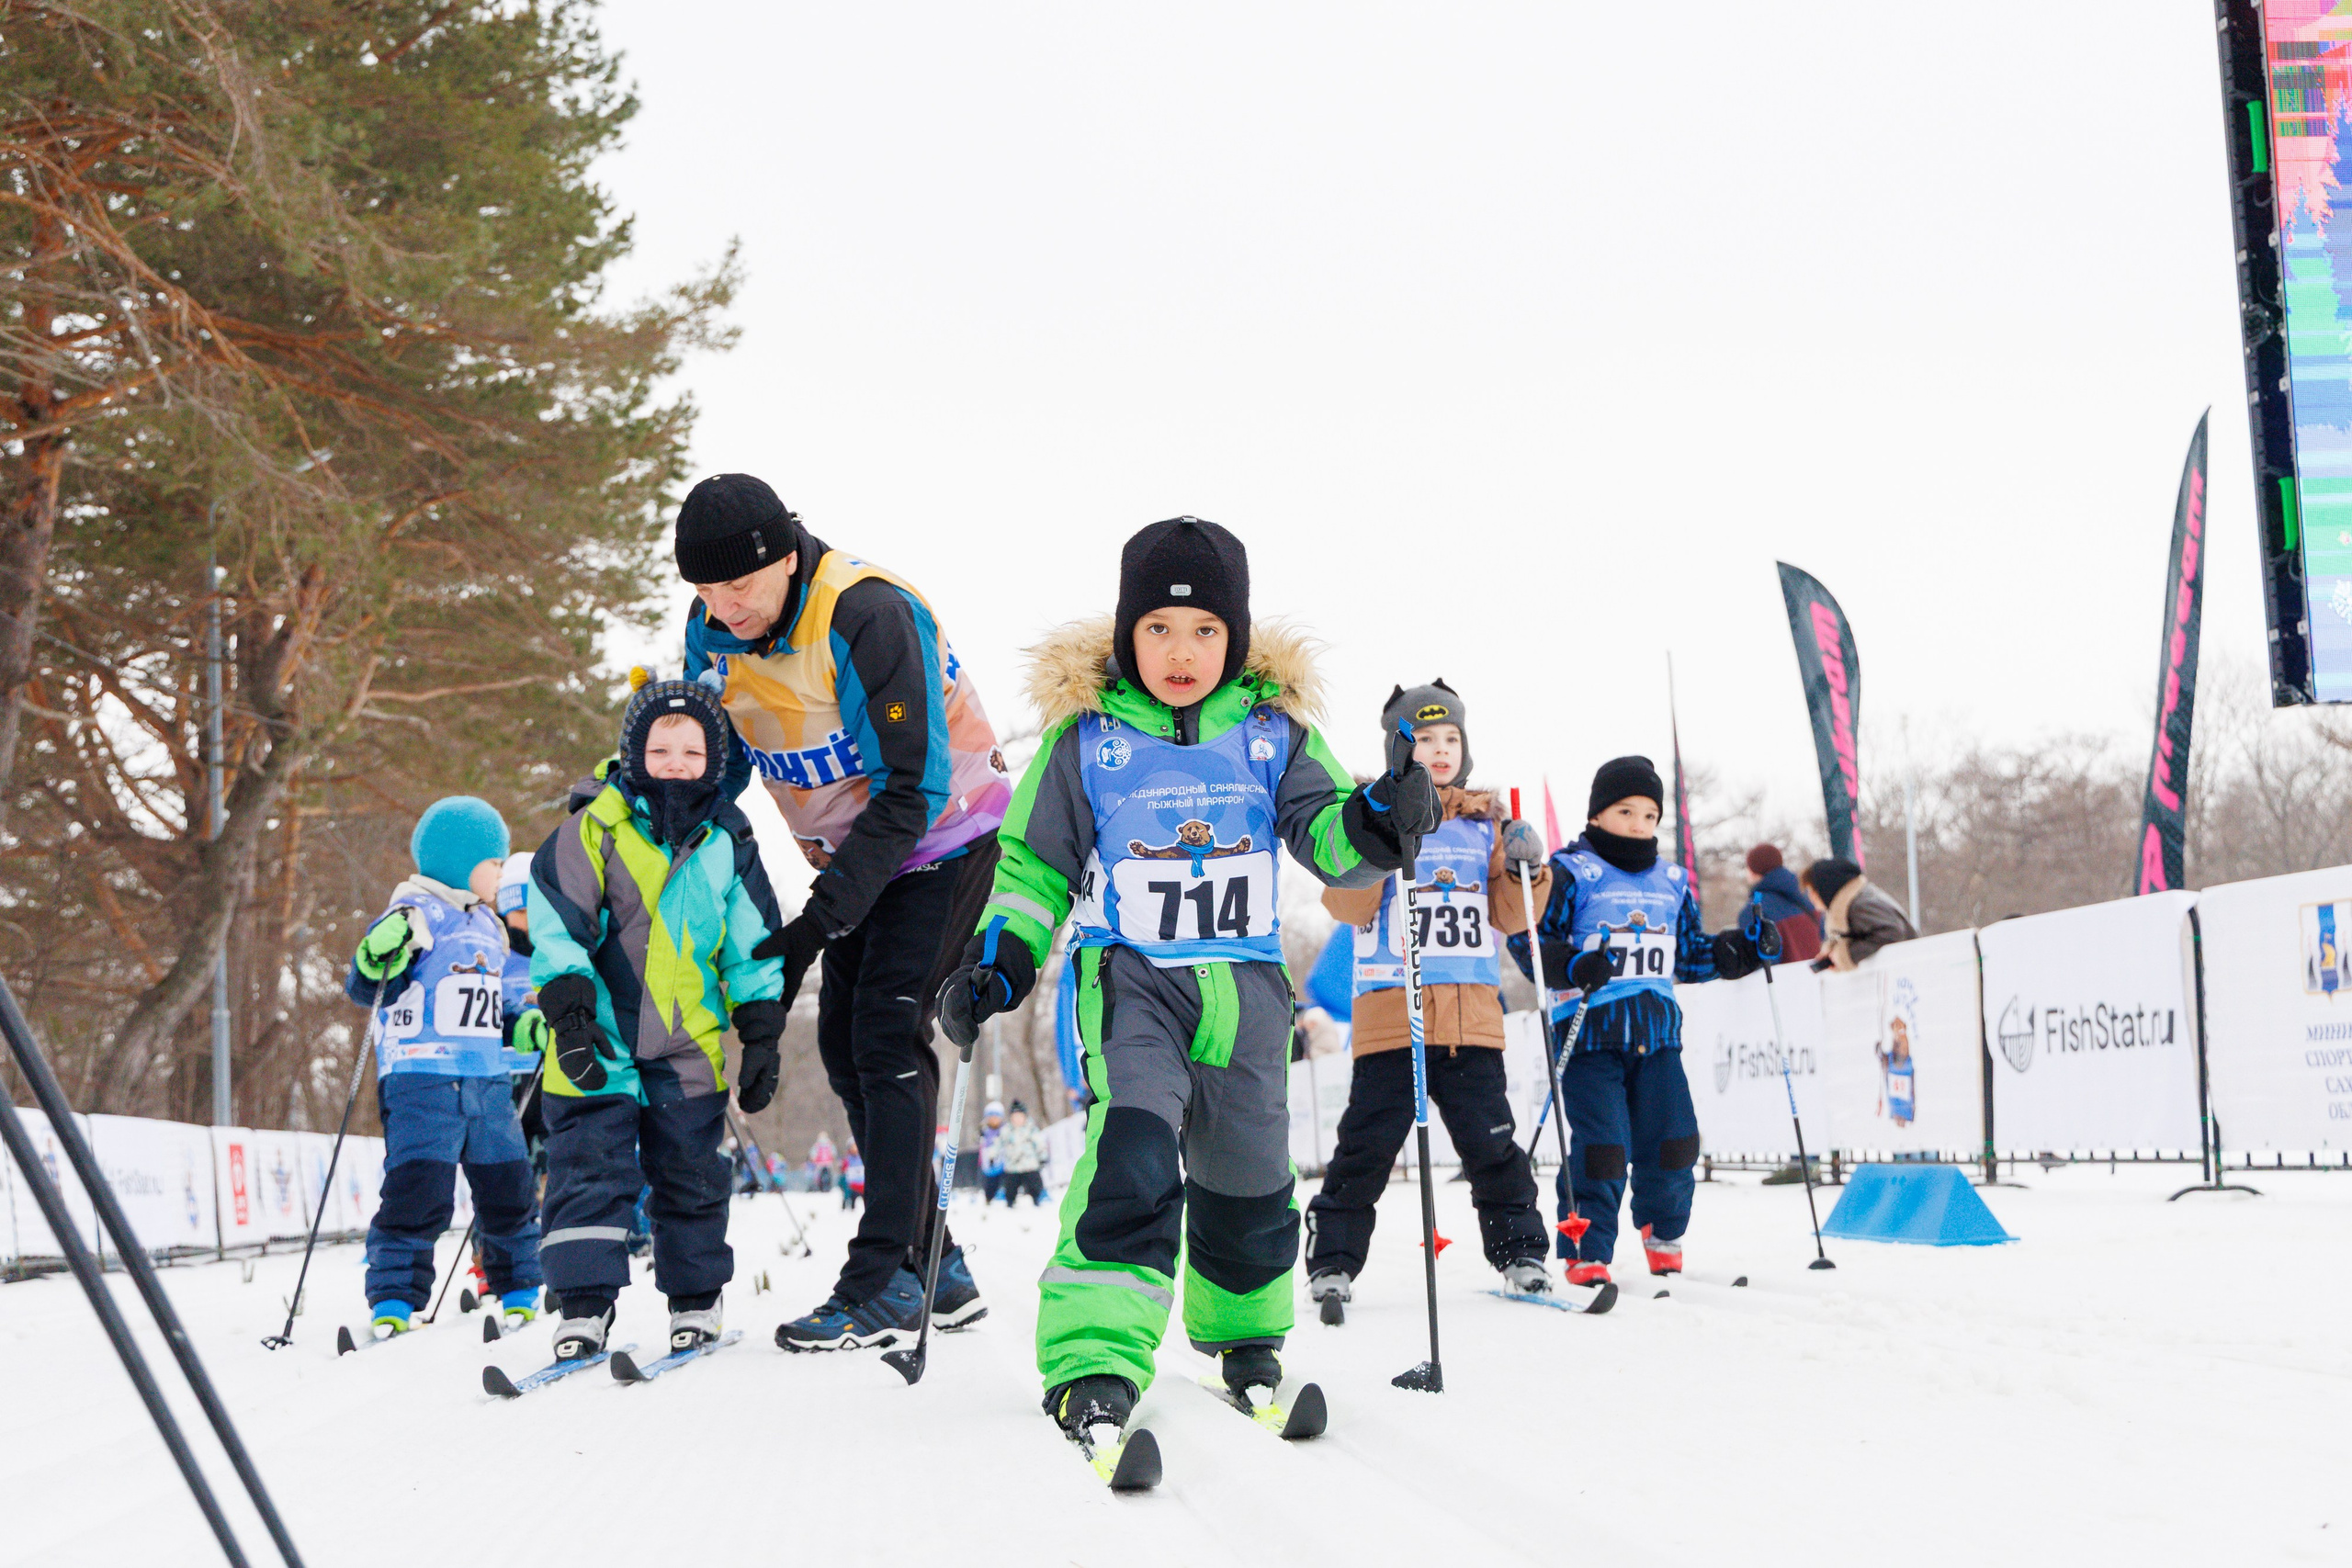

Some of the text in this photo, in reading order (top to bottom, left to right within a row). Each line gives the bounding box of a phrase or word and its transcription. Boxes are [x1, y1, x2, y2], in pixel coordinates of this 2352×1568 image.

[1148, 795, 1244, 809] ЛЫЖНЫЙ МАРАФОН
[1209, 783, 1268, 794] САХАЛИНСКИ
[1148, 875, 1250, 941] 714
[1417, 905, 1482, 948] 733
[1408, 887, 1422, 1010] BRADOS
[1606, 947, 1664, 976] 719
[458, 987, 503, 1030] 726
[2047, 1002, 2174, 1054] FishStat.ru
[941, 1163, 954, 1201] SPORT
